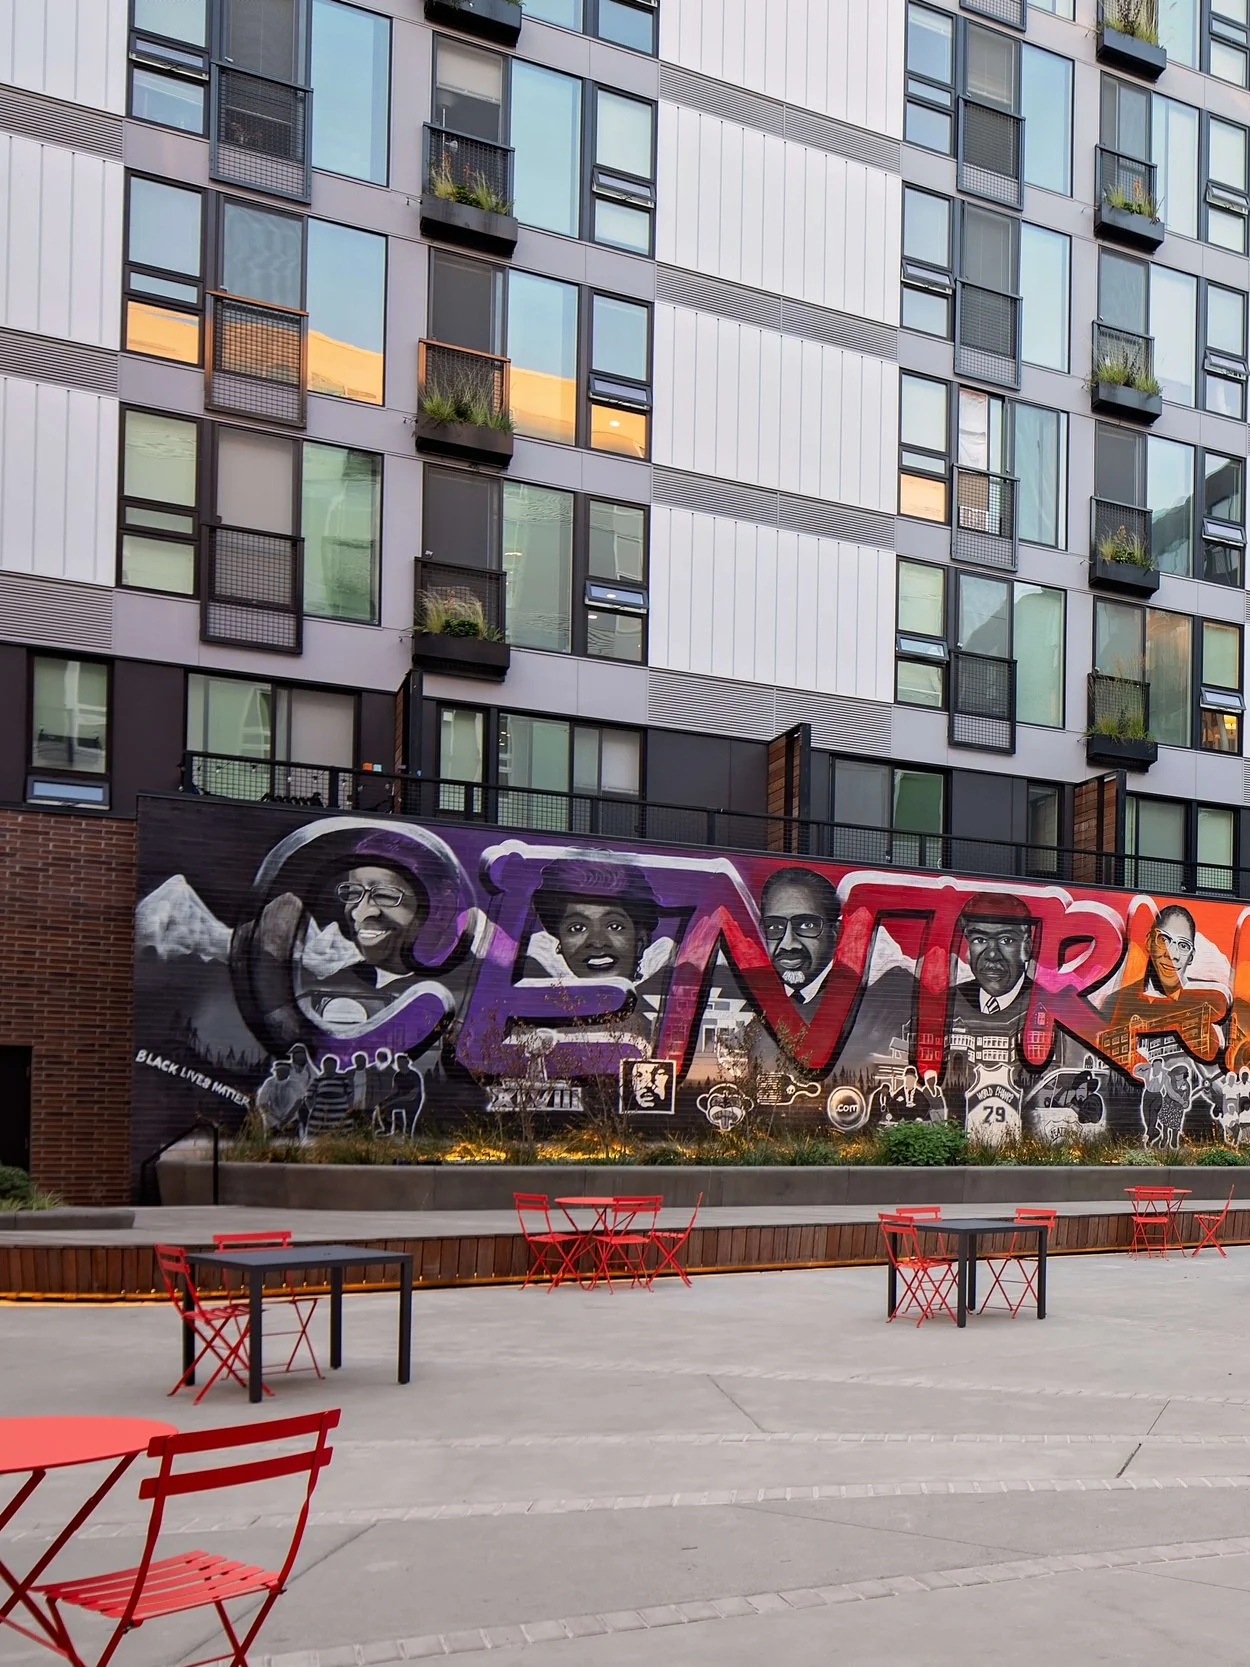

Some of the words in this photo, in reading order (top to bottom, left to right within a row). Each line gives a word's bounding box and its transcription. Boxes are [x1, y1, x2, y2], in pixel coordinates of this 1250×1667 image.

[135, 1049, 180, 1075] BLACK
[180, 1066, 212, 1089] LIVES
[211, 1081, 251, 1109] MATTER
[835, 1103, 859, 1113] .com
[982, 1105, 1006, 1123] 79
